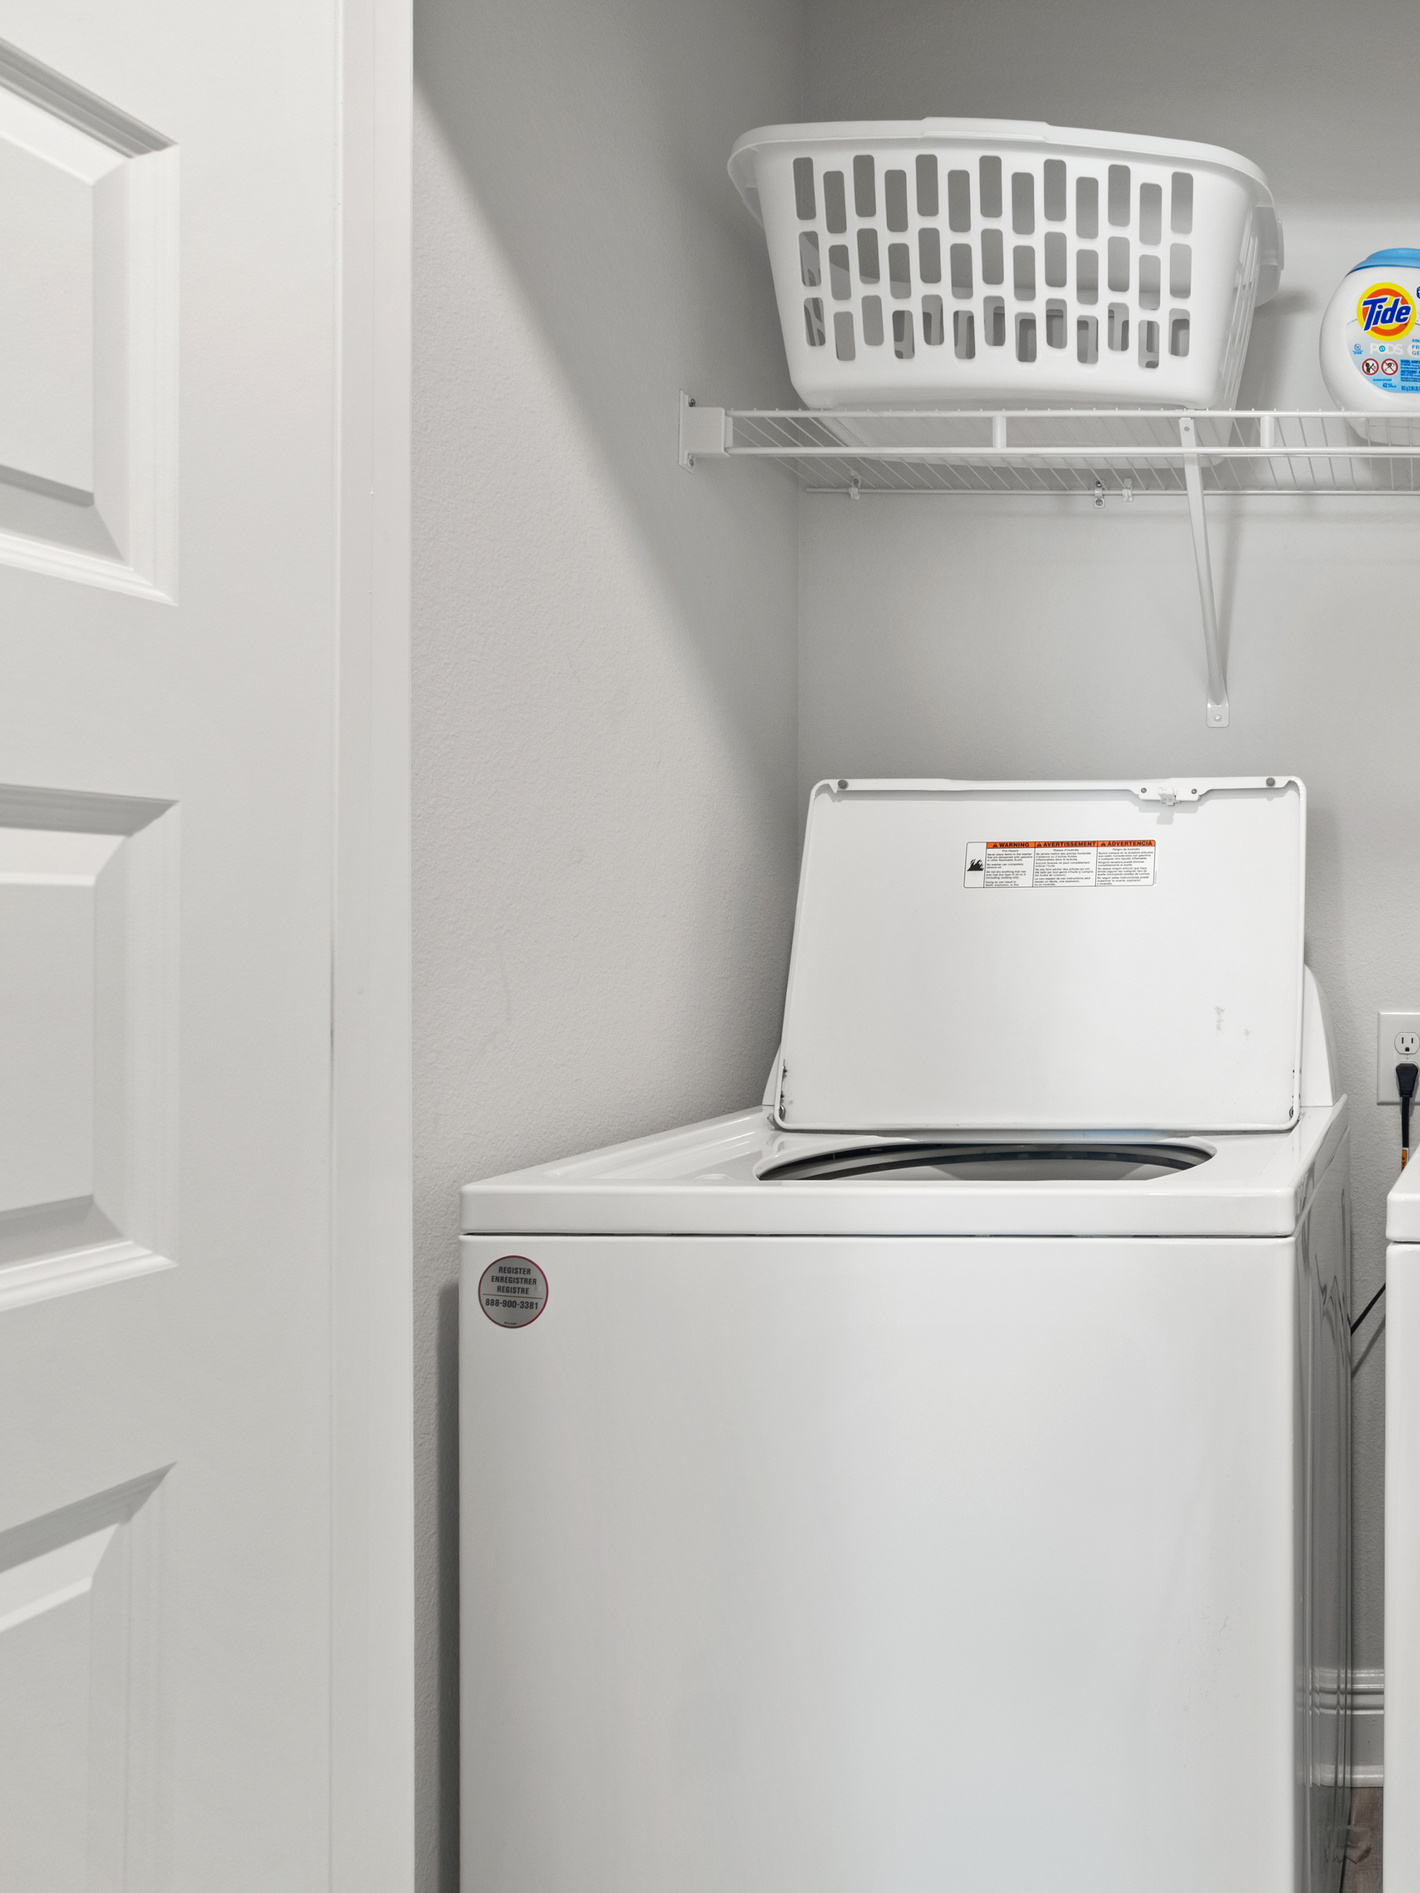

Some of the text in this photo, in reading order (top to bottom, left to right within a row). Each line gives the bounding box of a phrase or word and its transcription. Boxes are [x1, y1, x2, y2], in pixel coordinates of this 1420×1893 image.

[1362, 296, 1412, 332] Tide
[498, 1266, 532, 1275] REGISTER
[491, 1275, 537, 1285] ENREGISTRER
[497, 1285, 530, 1295] REGISTRE
[485, 1298, 538, 1310] 888-900-3381
